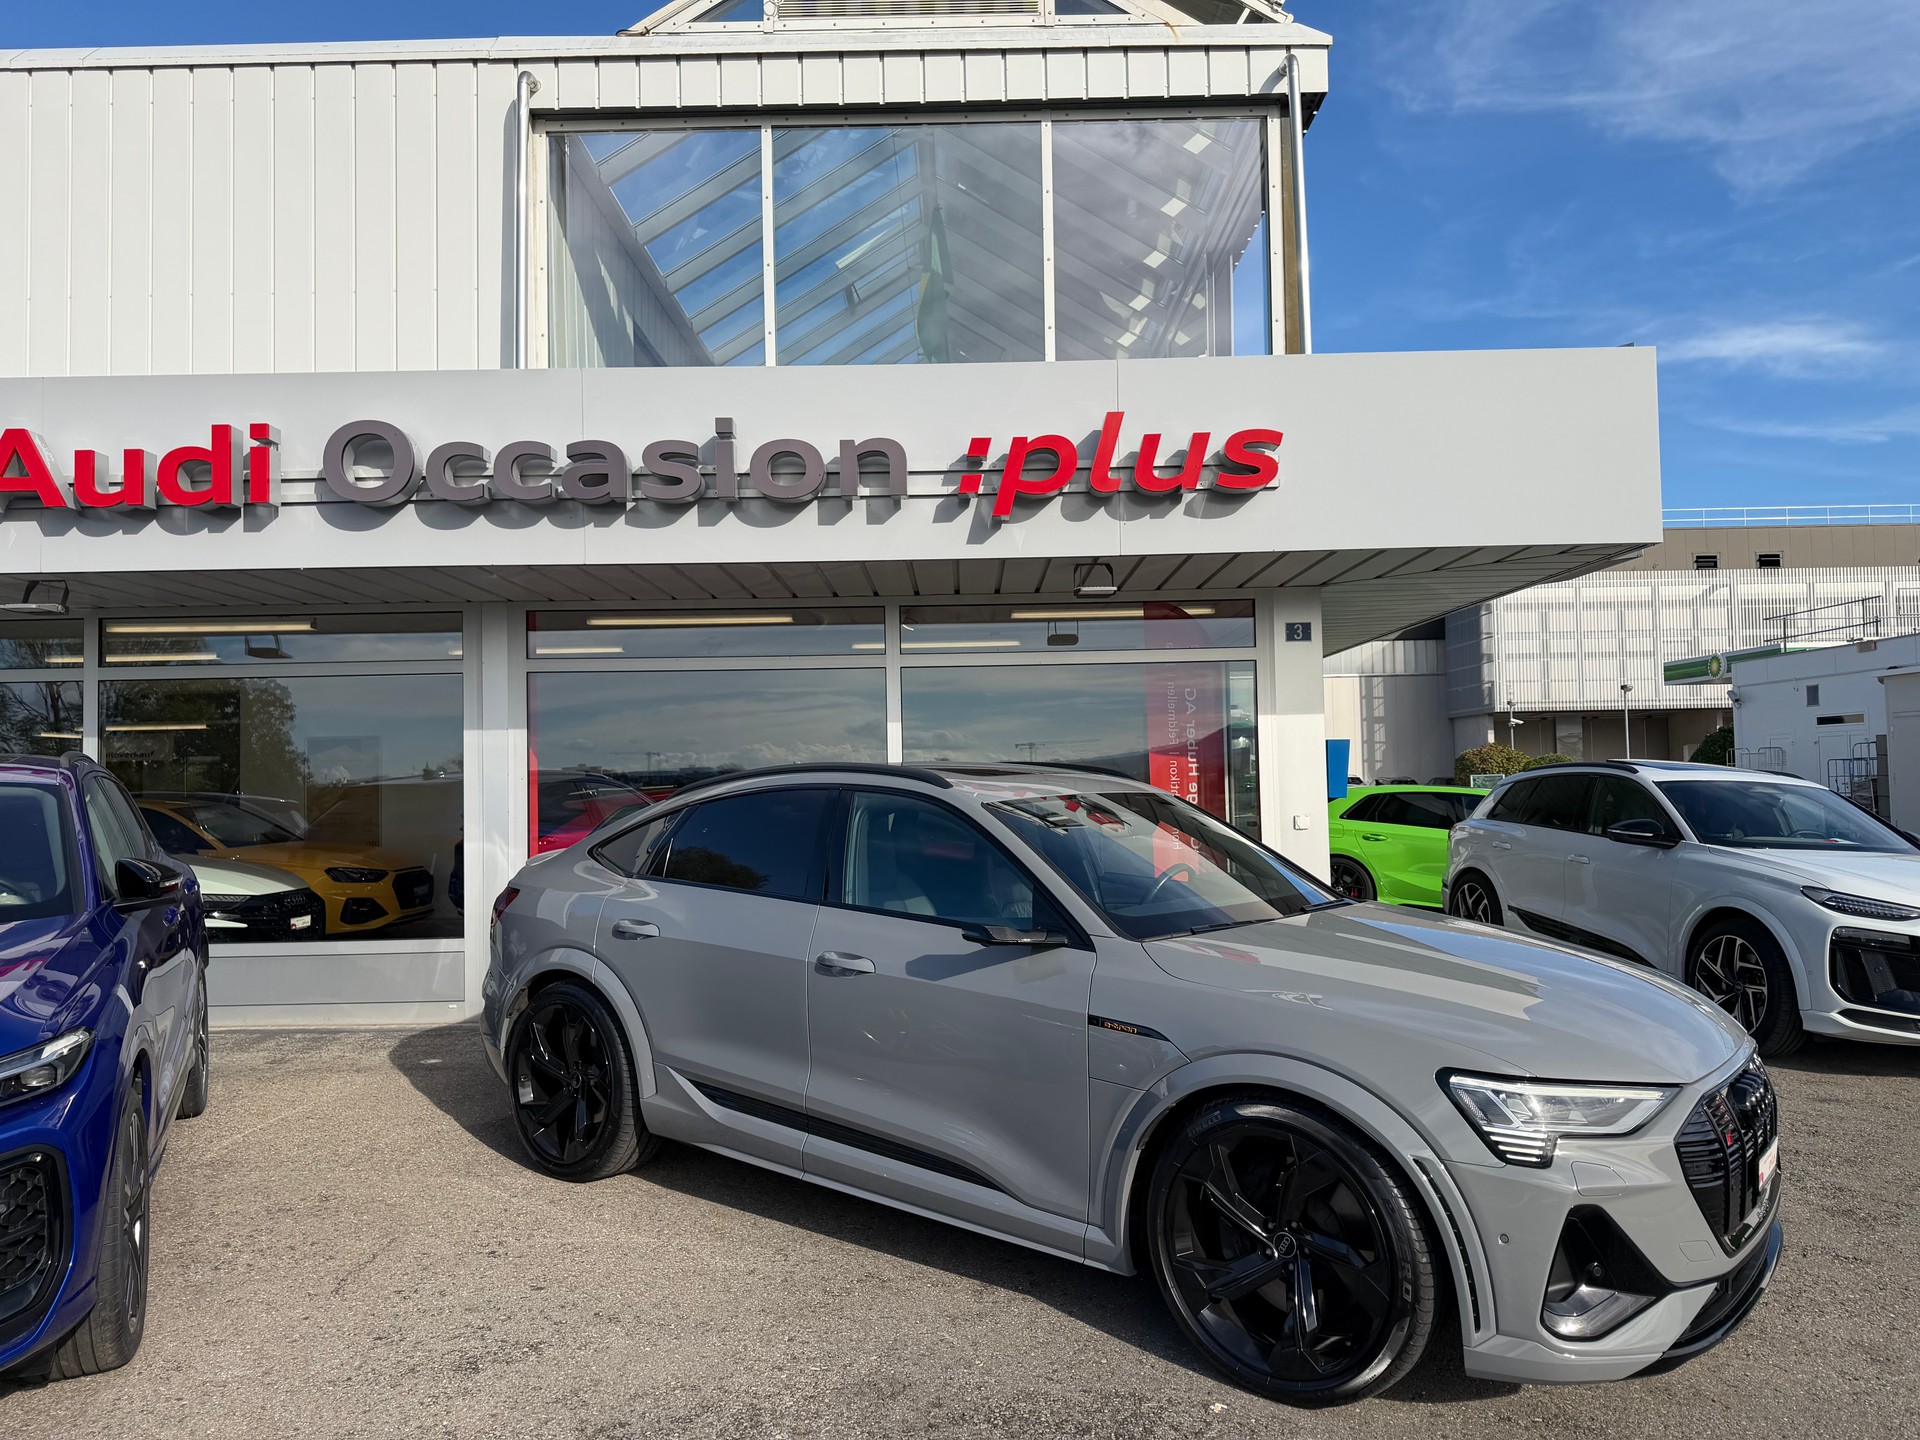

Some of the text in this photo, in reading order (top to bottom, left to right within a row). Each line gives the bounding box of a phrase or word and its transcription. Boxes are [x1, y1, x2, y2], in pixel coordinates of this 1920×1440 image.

[0, 423, 273, 509] Audi
[323, 417, 908, 502] Occasion
[1293, 624, 1303, 640] 3
